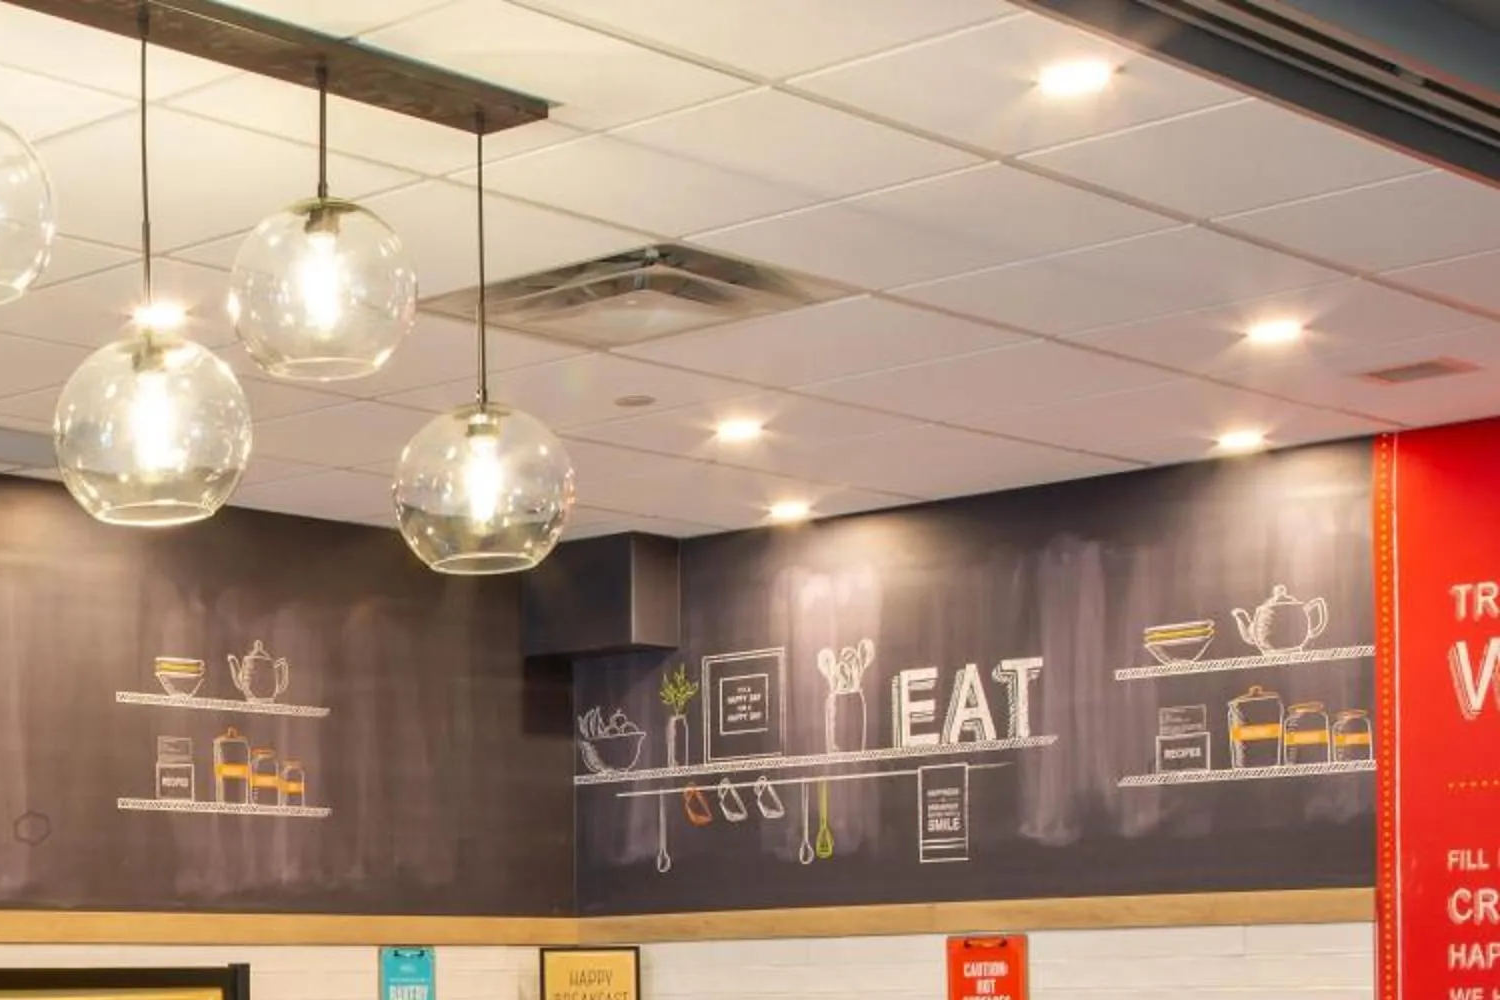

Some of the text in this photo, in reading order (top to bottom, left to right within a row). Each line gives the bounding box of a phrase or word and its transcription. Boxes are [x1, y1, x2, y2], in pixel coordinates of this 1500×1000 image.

[1449, 580, 1500, 622] TR
[892, 657, 1044, 747] EAT
[1447, 848, 1490, 871] FILL
[1447, 887, 1500, 925] CR
[569, 968, 613, 987] HAPPY
